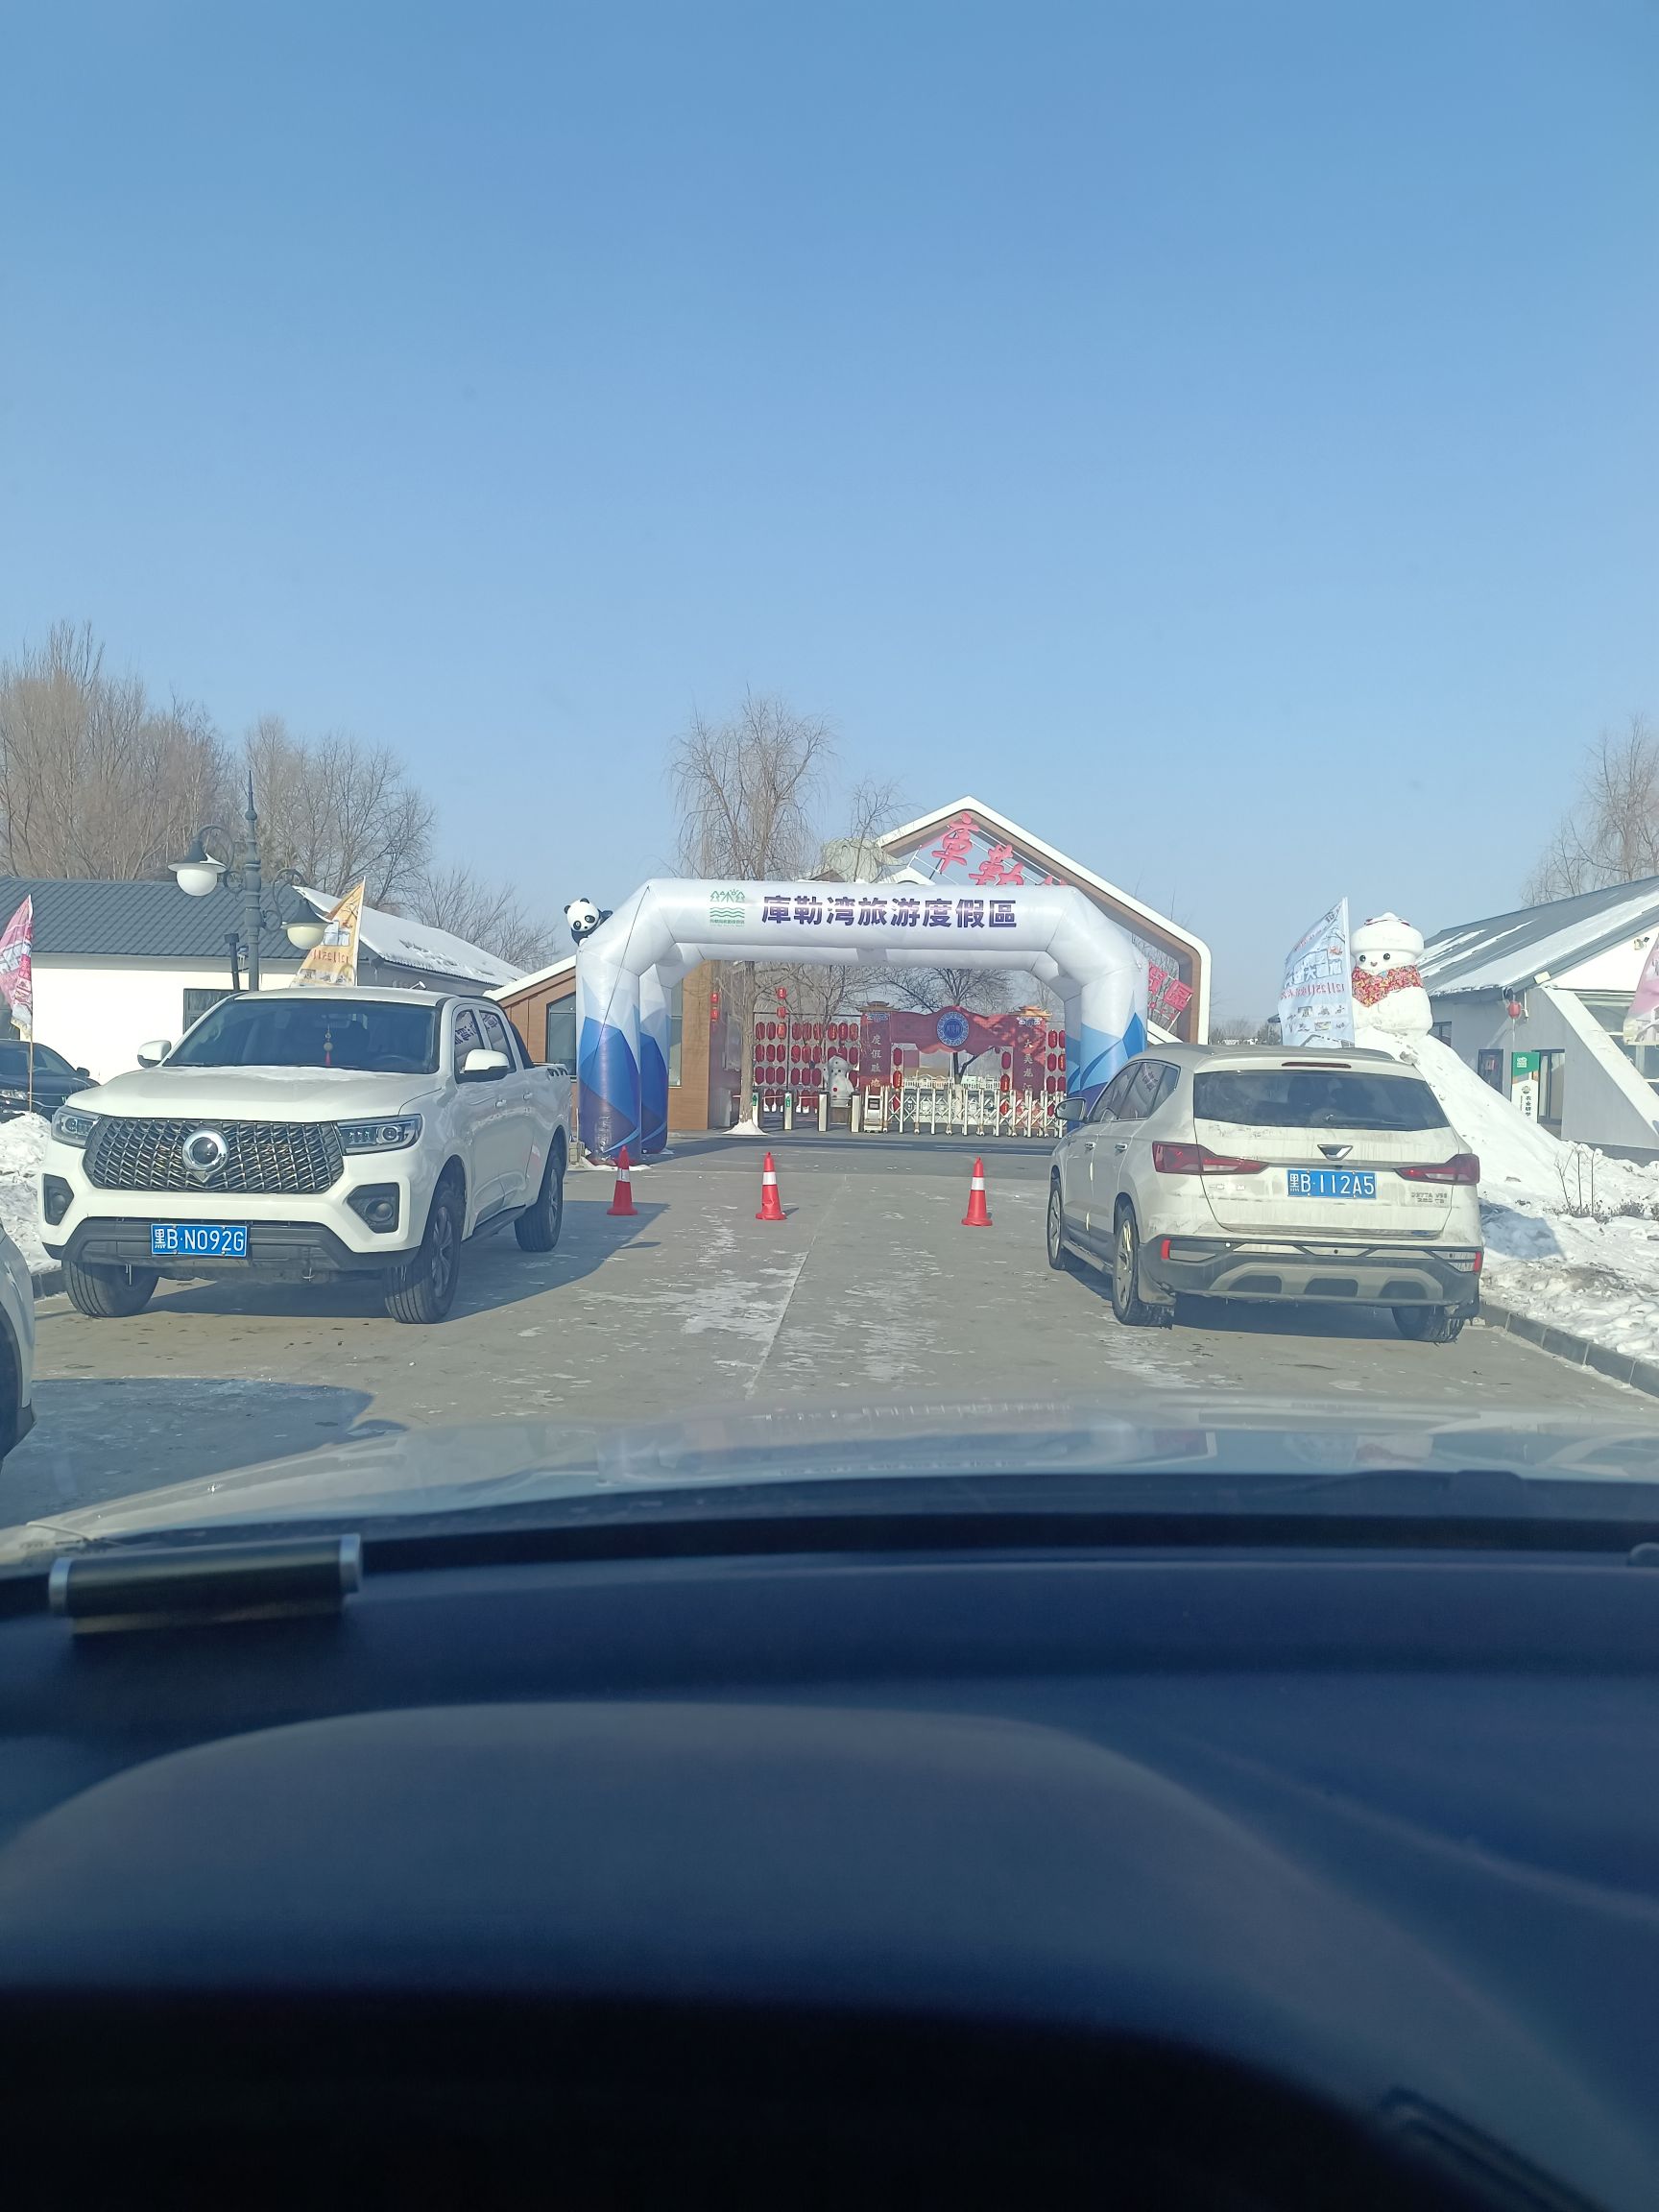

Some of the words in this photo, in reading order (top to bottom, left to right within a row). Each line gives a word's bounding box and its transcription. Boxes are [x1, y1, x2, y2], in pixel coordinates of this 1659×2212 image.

[761, 895, 1018, 928] 庫勒湾旅游度假區
